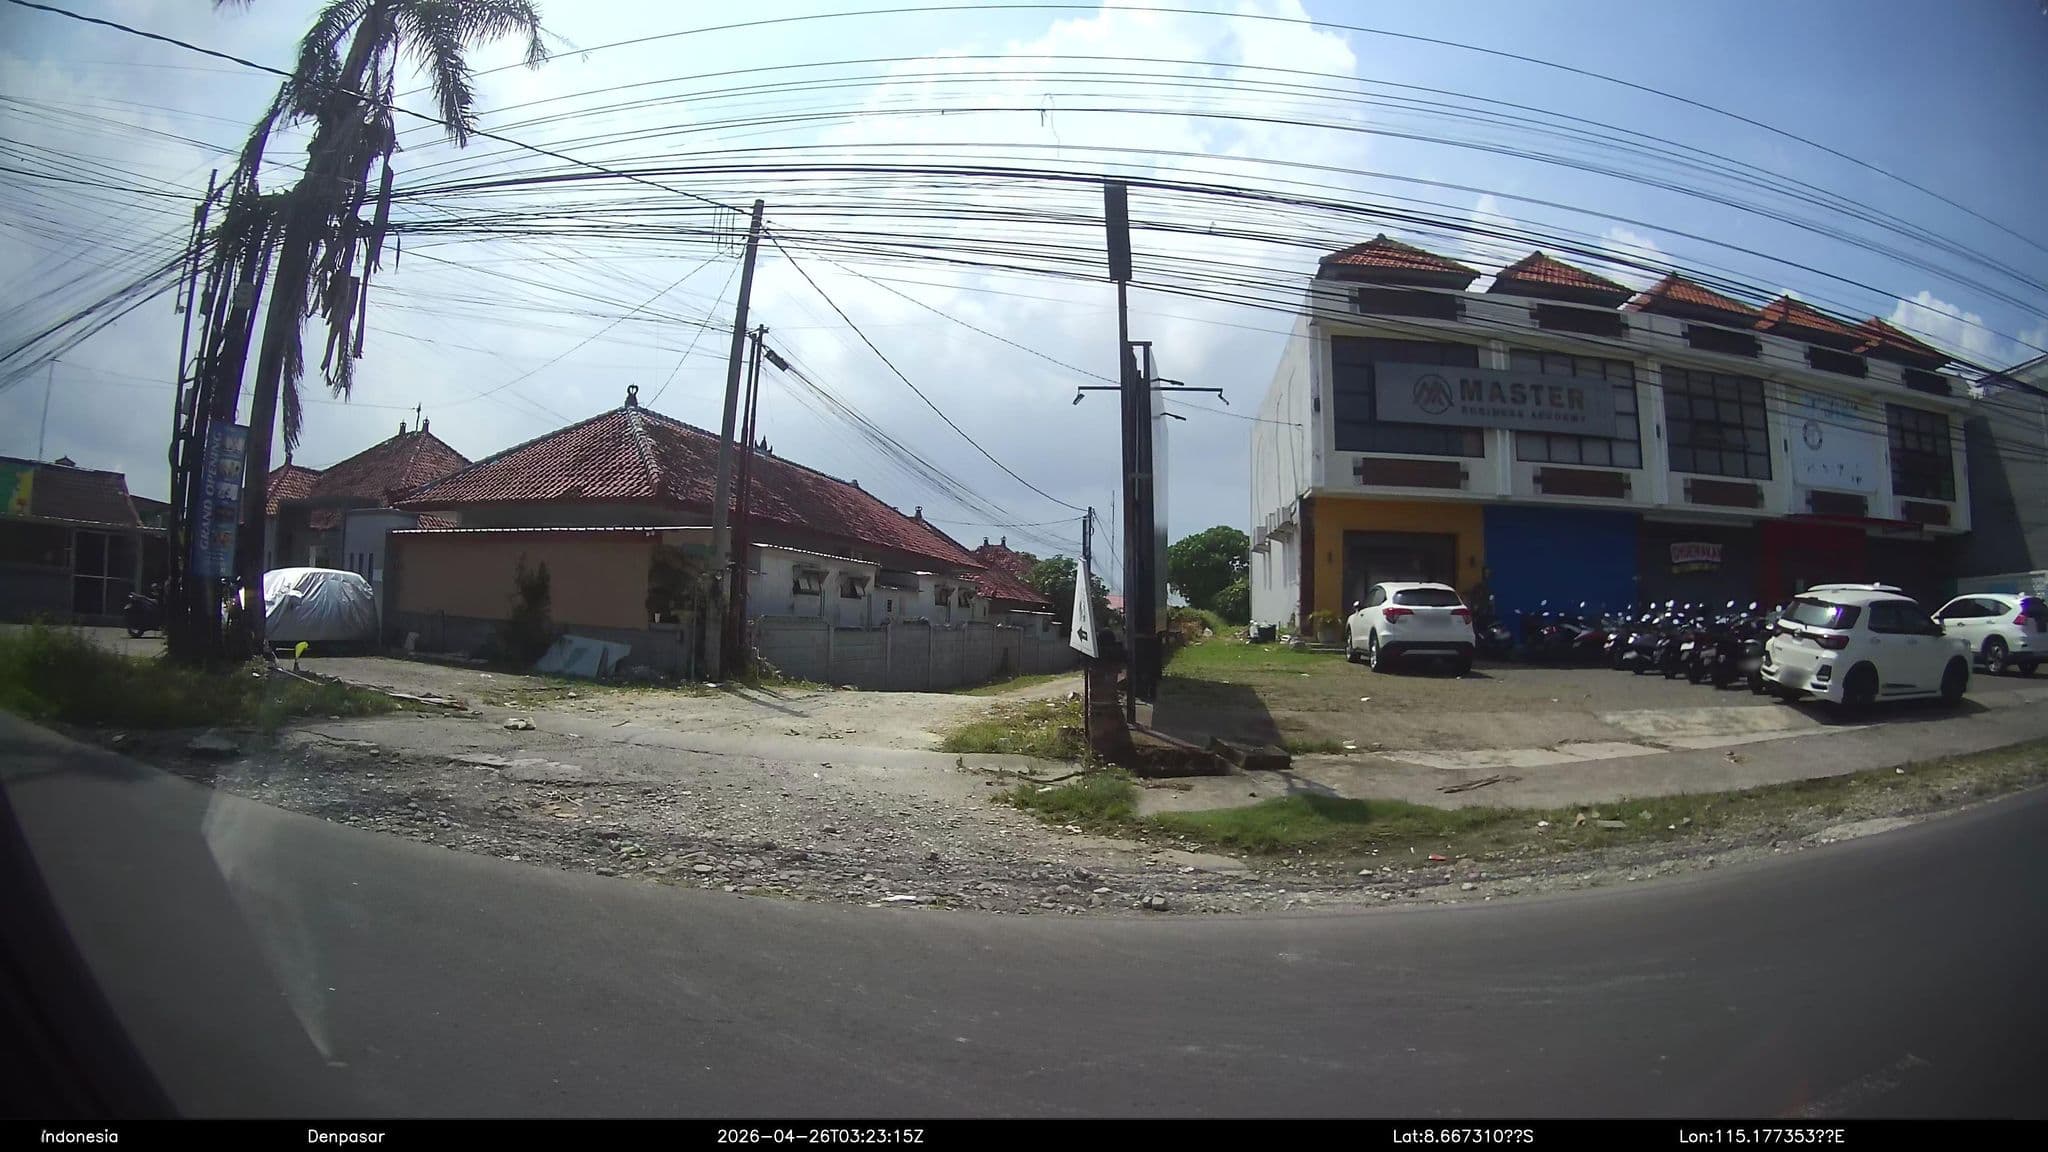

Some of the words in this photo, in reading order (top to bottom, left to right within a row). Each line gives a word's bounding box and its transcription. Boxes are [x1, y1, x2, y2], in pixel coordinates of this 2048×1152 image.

[1459, 379, 1585, 410] MASTER
[206, 431, 222, 496] OPENING
[201, 500, 213, 549] GRAND
